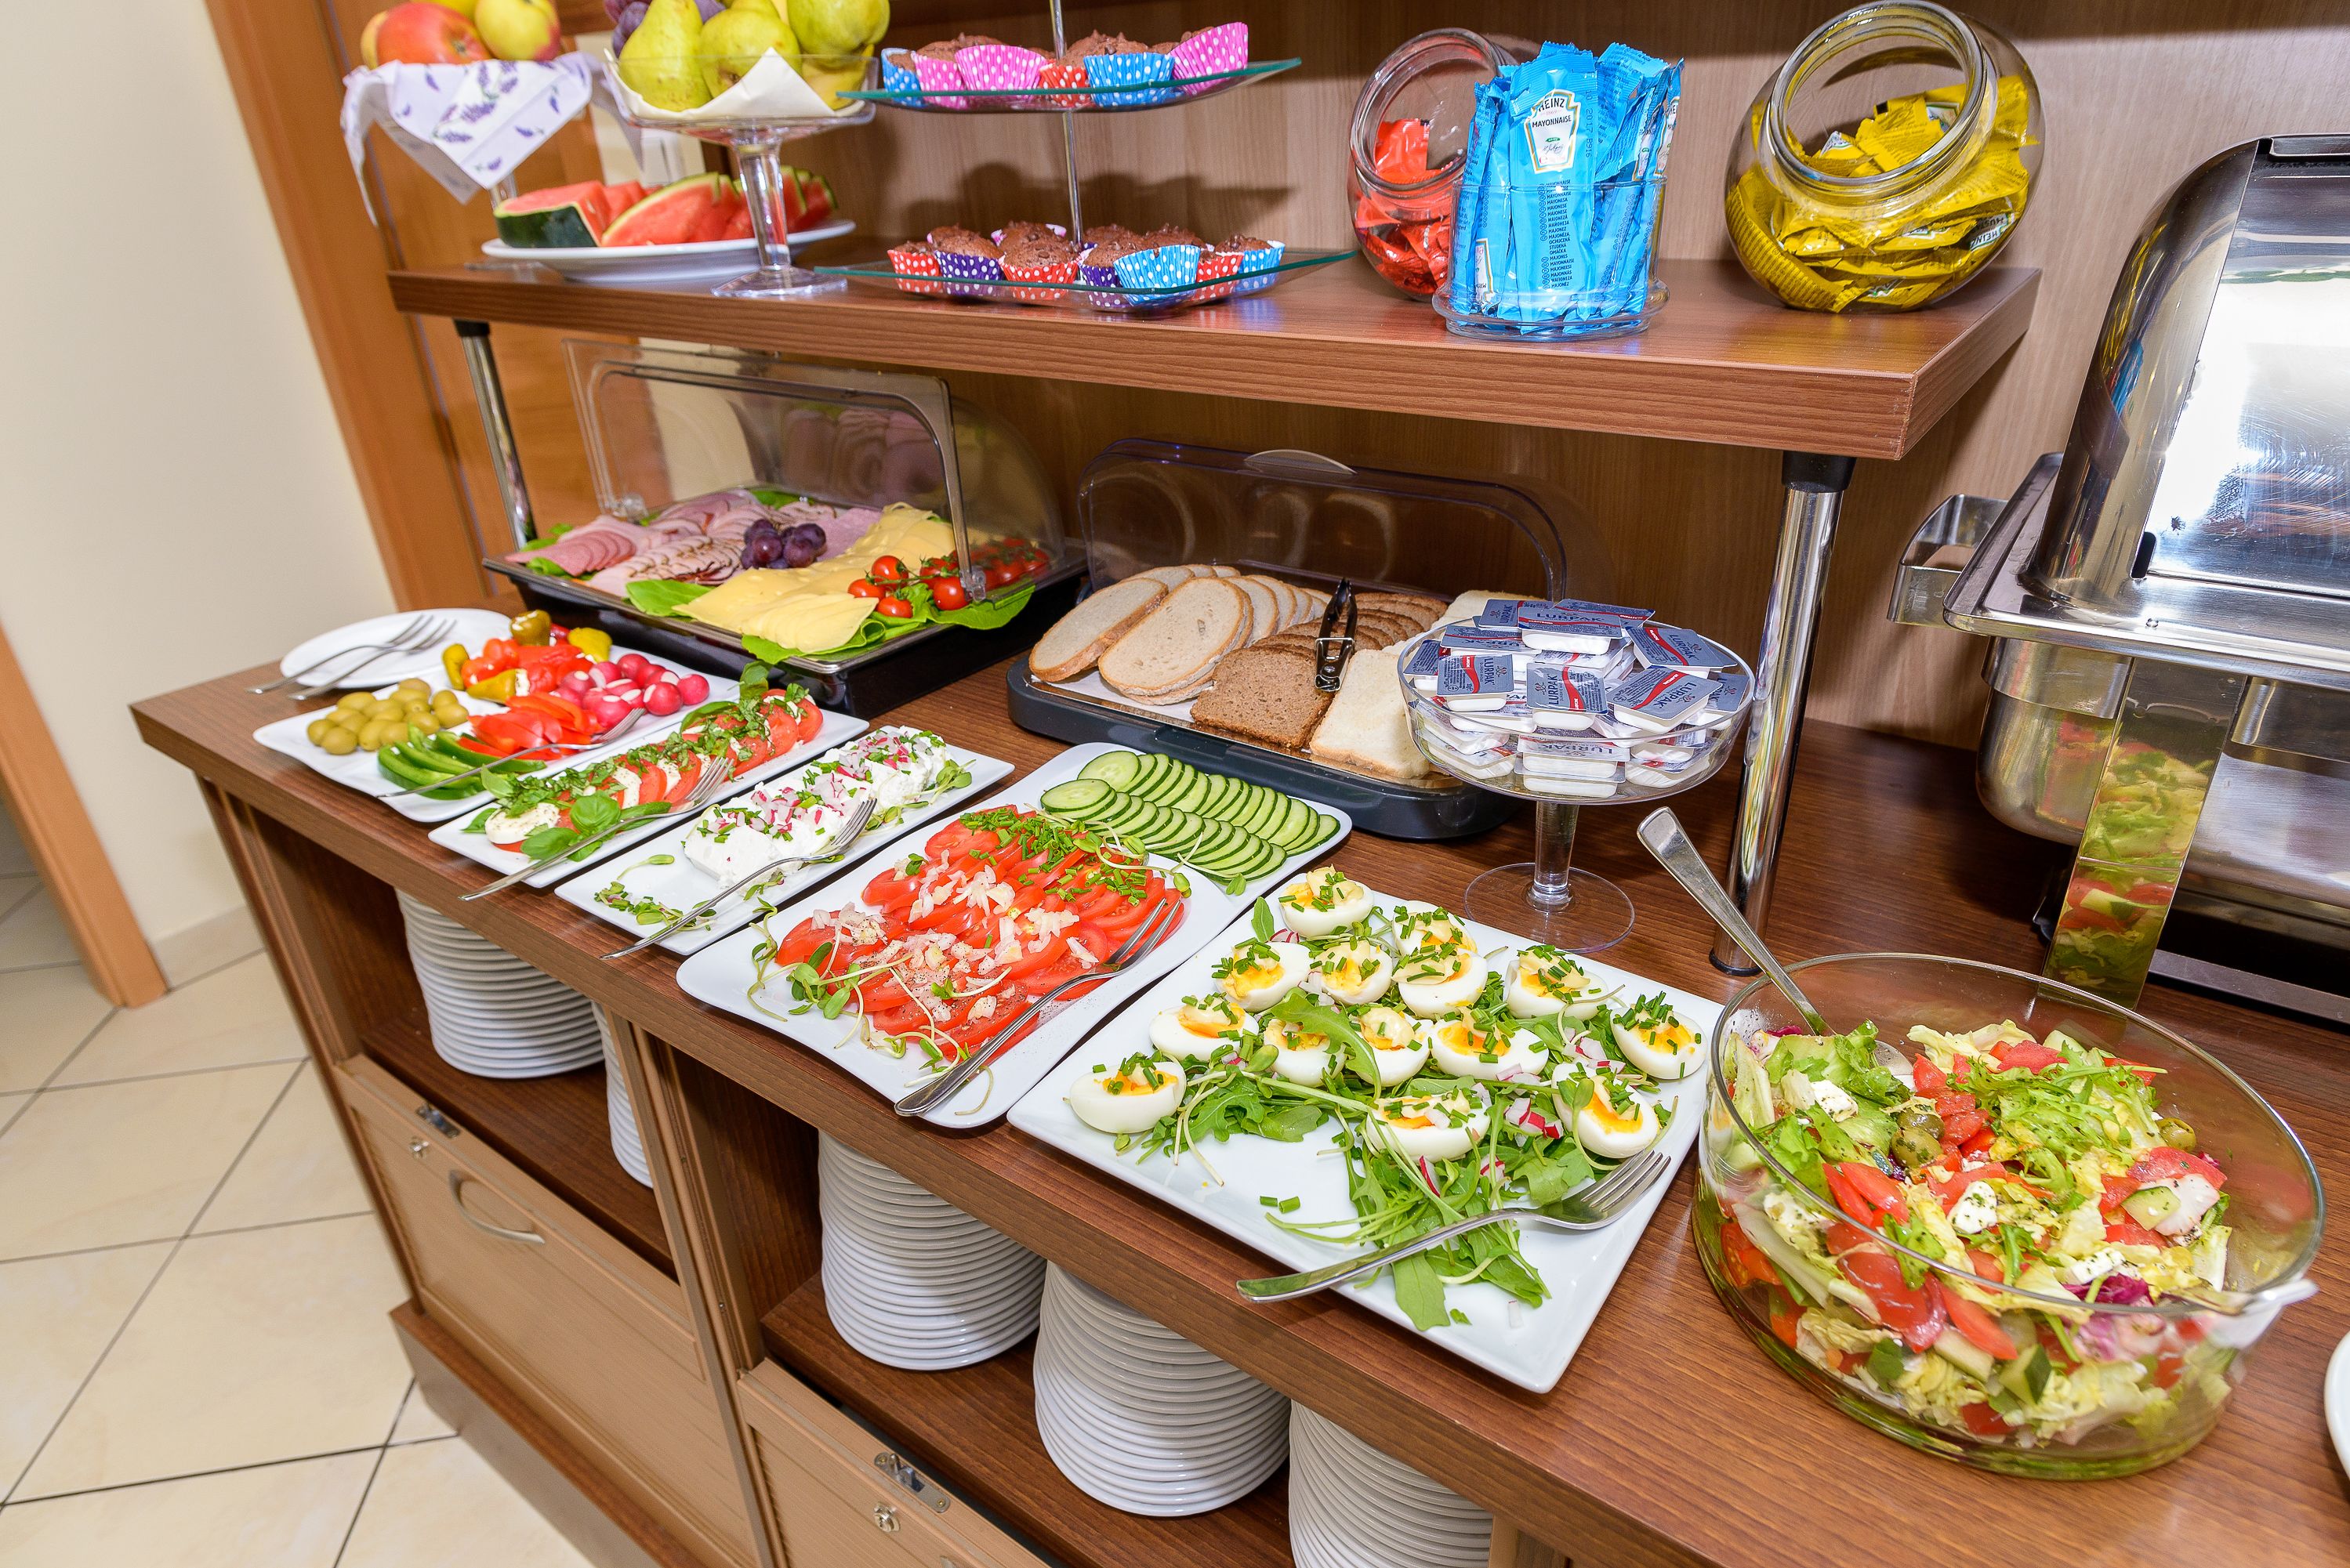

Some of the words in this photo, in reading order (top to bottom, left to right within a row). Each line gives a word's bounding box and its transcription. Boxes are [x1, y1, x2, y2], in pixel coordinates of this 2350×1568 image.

[1539, 97, 1565, 112] HEINZ
[1532, 115, 1572, 128] MAYONNAISE
[1970, 230, 1998, 248] HEINZ
[1499, 604, 1513, 624] LURPAK
[1536, 613, 1604, 622] LURPAK
[1463, 639, 1525, 648] URPAK
[1669, 634, 1699, 660] LURPAK
[1484, 657, 1495, 686] LURPAK
[1548, 674, 1559, 705] LURPAK
[1654, 682, 1697, 708] LURPAK
[1538, 744, 1612, 755] LURPAK
